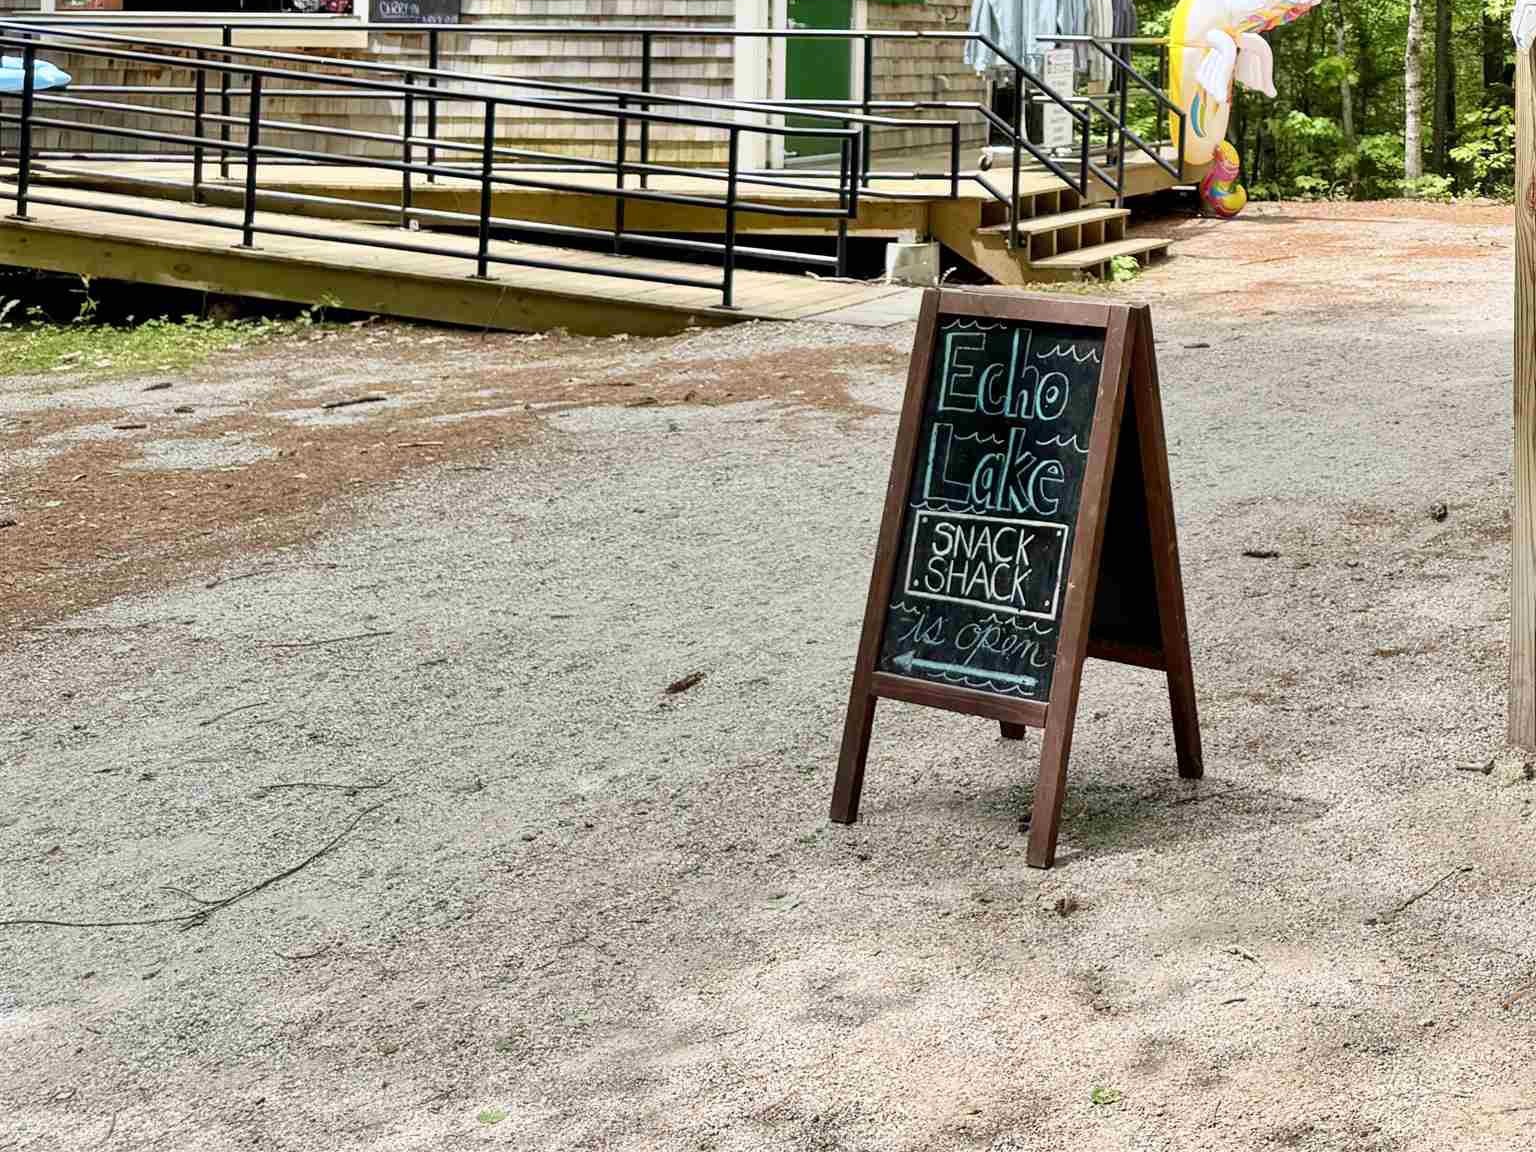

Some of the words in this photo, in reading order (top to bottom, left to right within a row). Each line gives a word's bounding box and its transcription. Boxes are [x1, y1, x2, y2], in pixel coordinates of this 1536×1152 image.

[938, 328, 1070, 421] Echo
[923, 423, 1065, 515] Lake
[932, 521, 1035, 566] SNACK
[924, 557, 1033, 606] SHACK
[899, 608, 945, 647] is
[954, 613, 1048, 668] open
